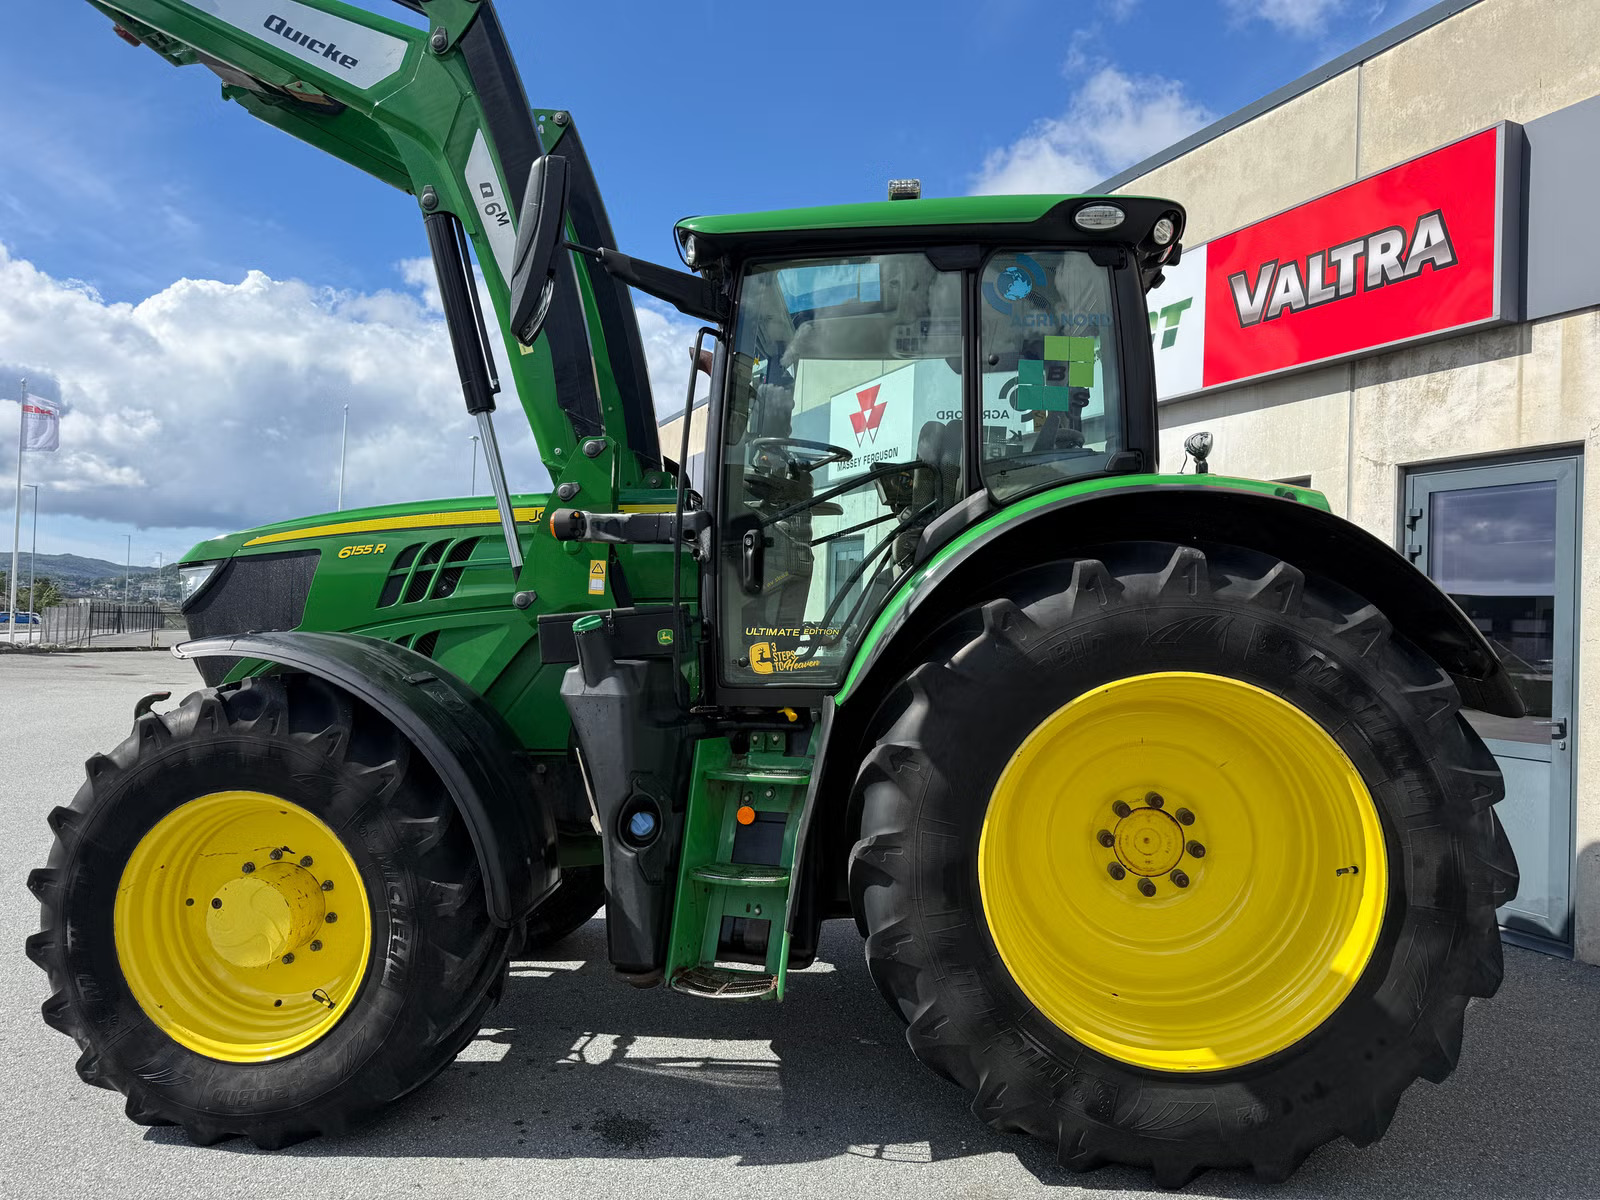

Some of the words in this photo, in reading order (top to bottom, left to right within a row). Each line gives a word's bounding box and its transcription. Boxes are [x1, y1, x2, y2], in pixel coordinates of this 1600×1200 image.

[263, 14, 359, 70] Quicke
[1227, 208, 1459, 328] VALTRA
[1010, 312, 1056, 328] AGRI
[1060, 312, 1112, 328] NORD
[837, 457, 861, 472] MASSEY
[863, 446, 899, 465] FERGUSON
[745, 627, 801, 637] ULTIMATE
[803, 628, 840, 636] EDITION
[771, 642, 777, 652] 3
[773, 650, 796, 662] STEPS
[774, 661, 784, 672] TO
[783, 657, 821, 672] Heaven
